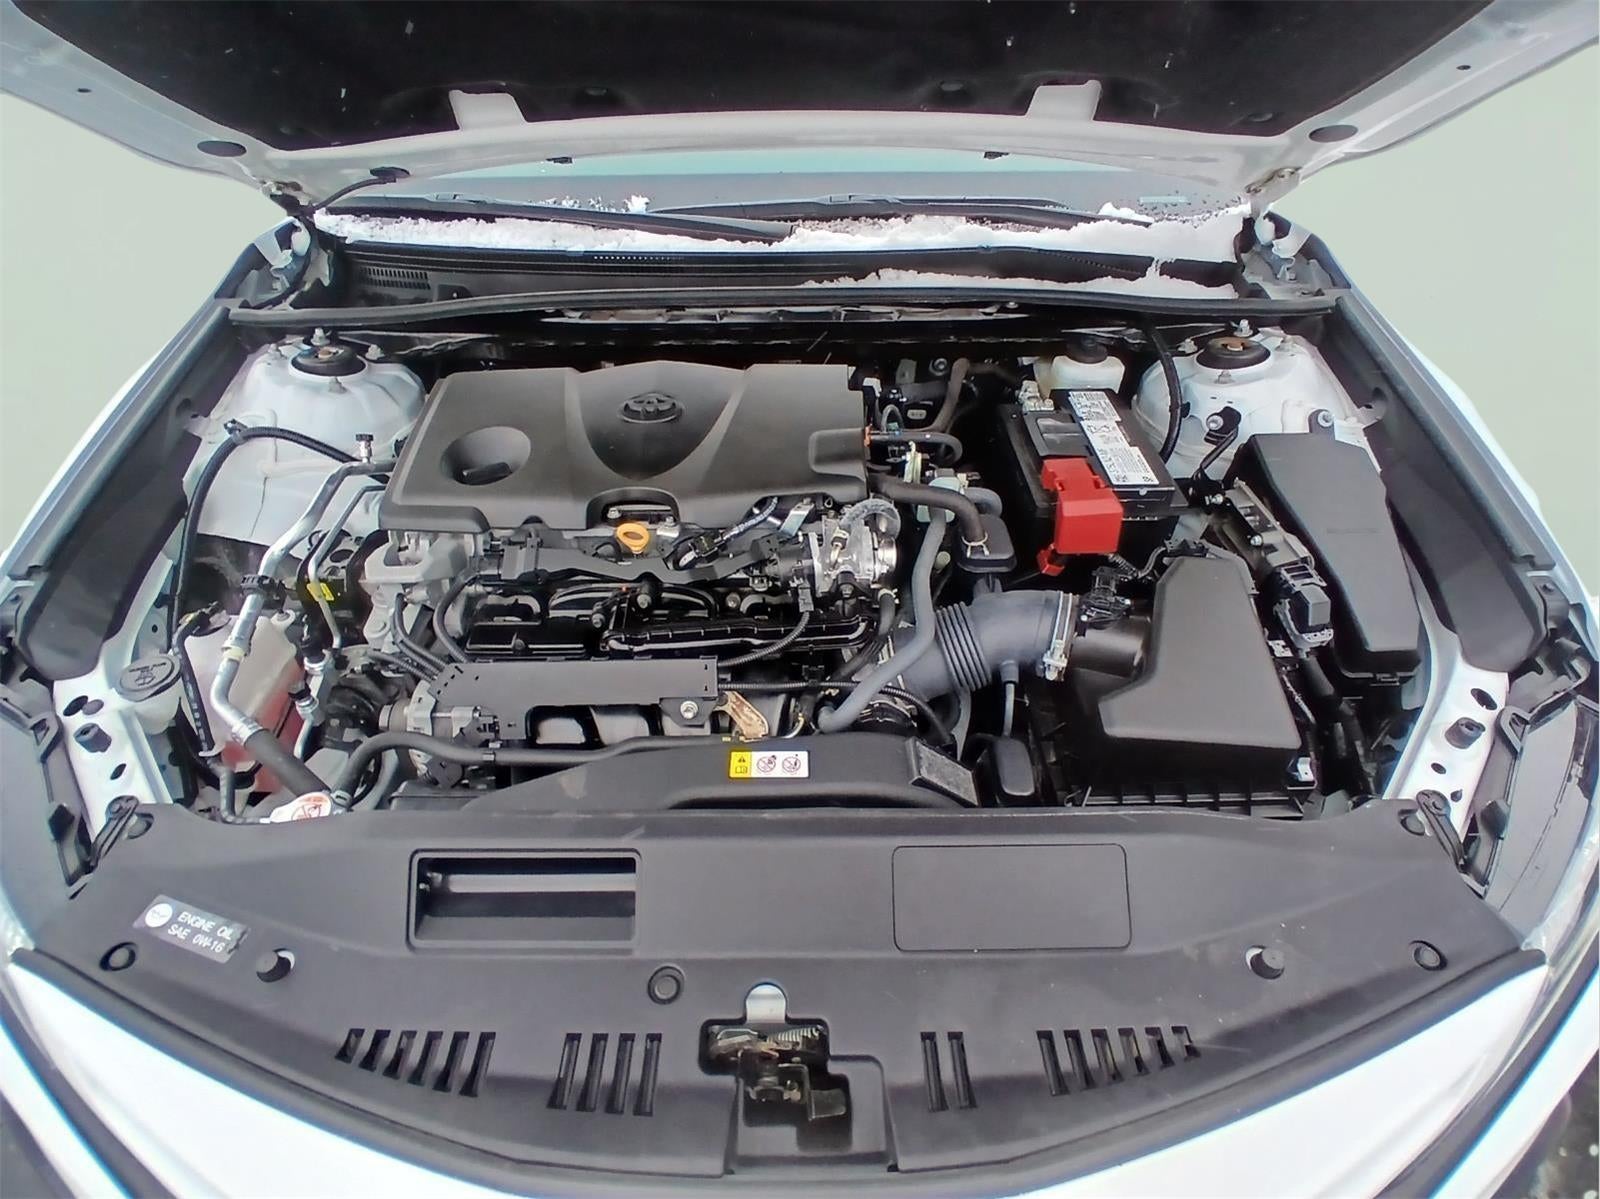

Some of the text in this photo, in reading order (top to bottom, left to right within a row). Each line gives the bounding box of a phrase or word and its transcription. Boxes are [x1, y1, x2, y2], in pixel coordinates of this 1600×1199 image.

[168, 923, 191, 940] SAE
[177, 911, 235, 941] ENGINE OIL
